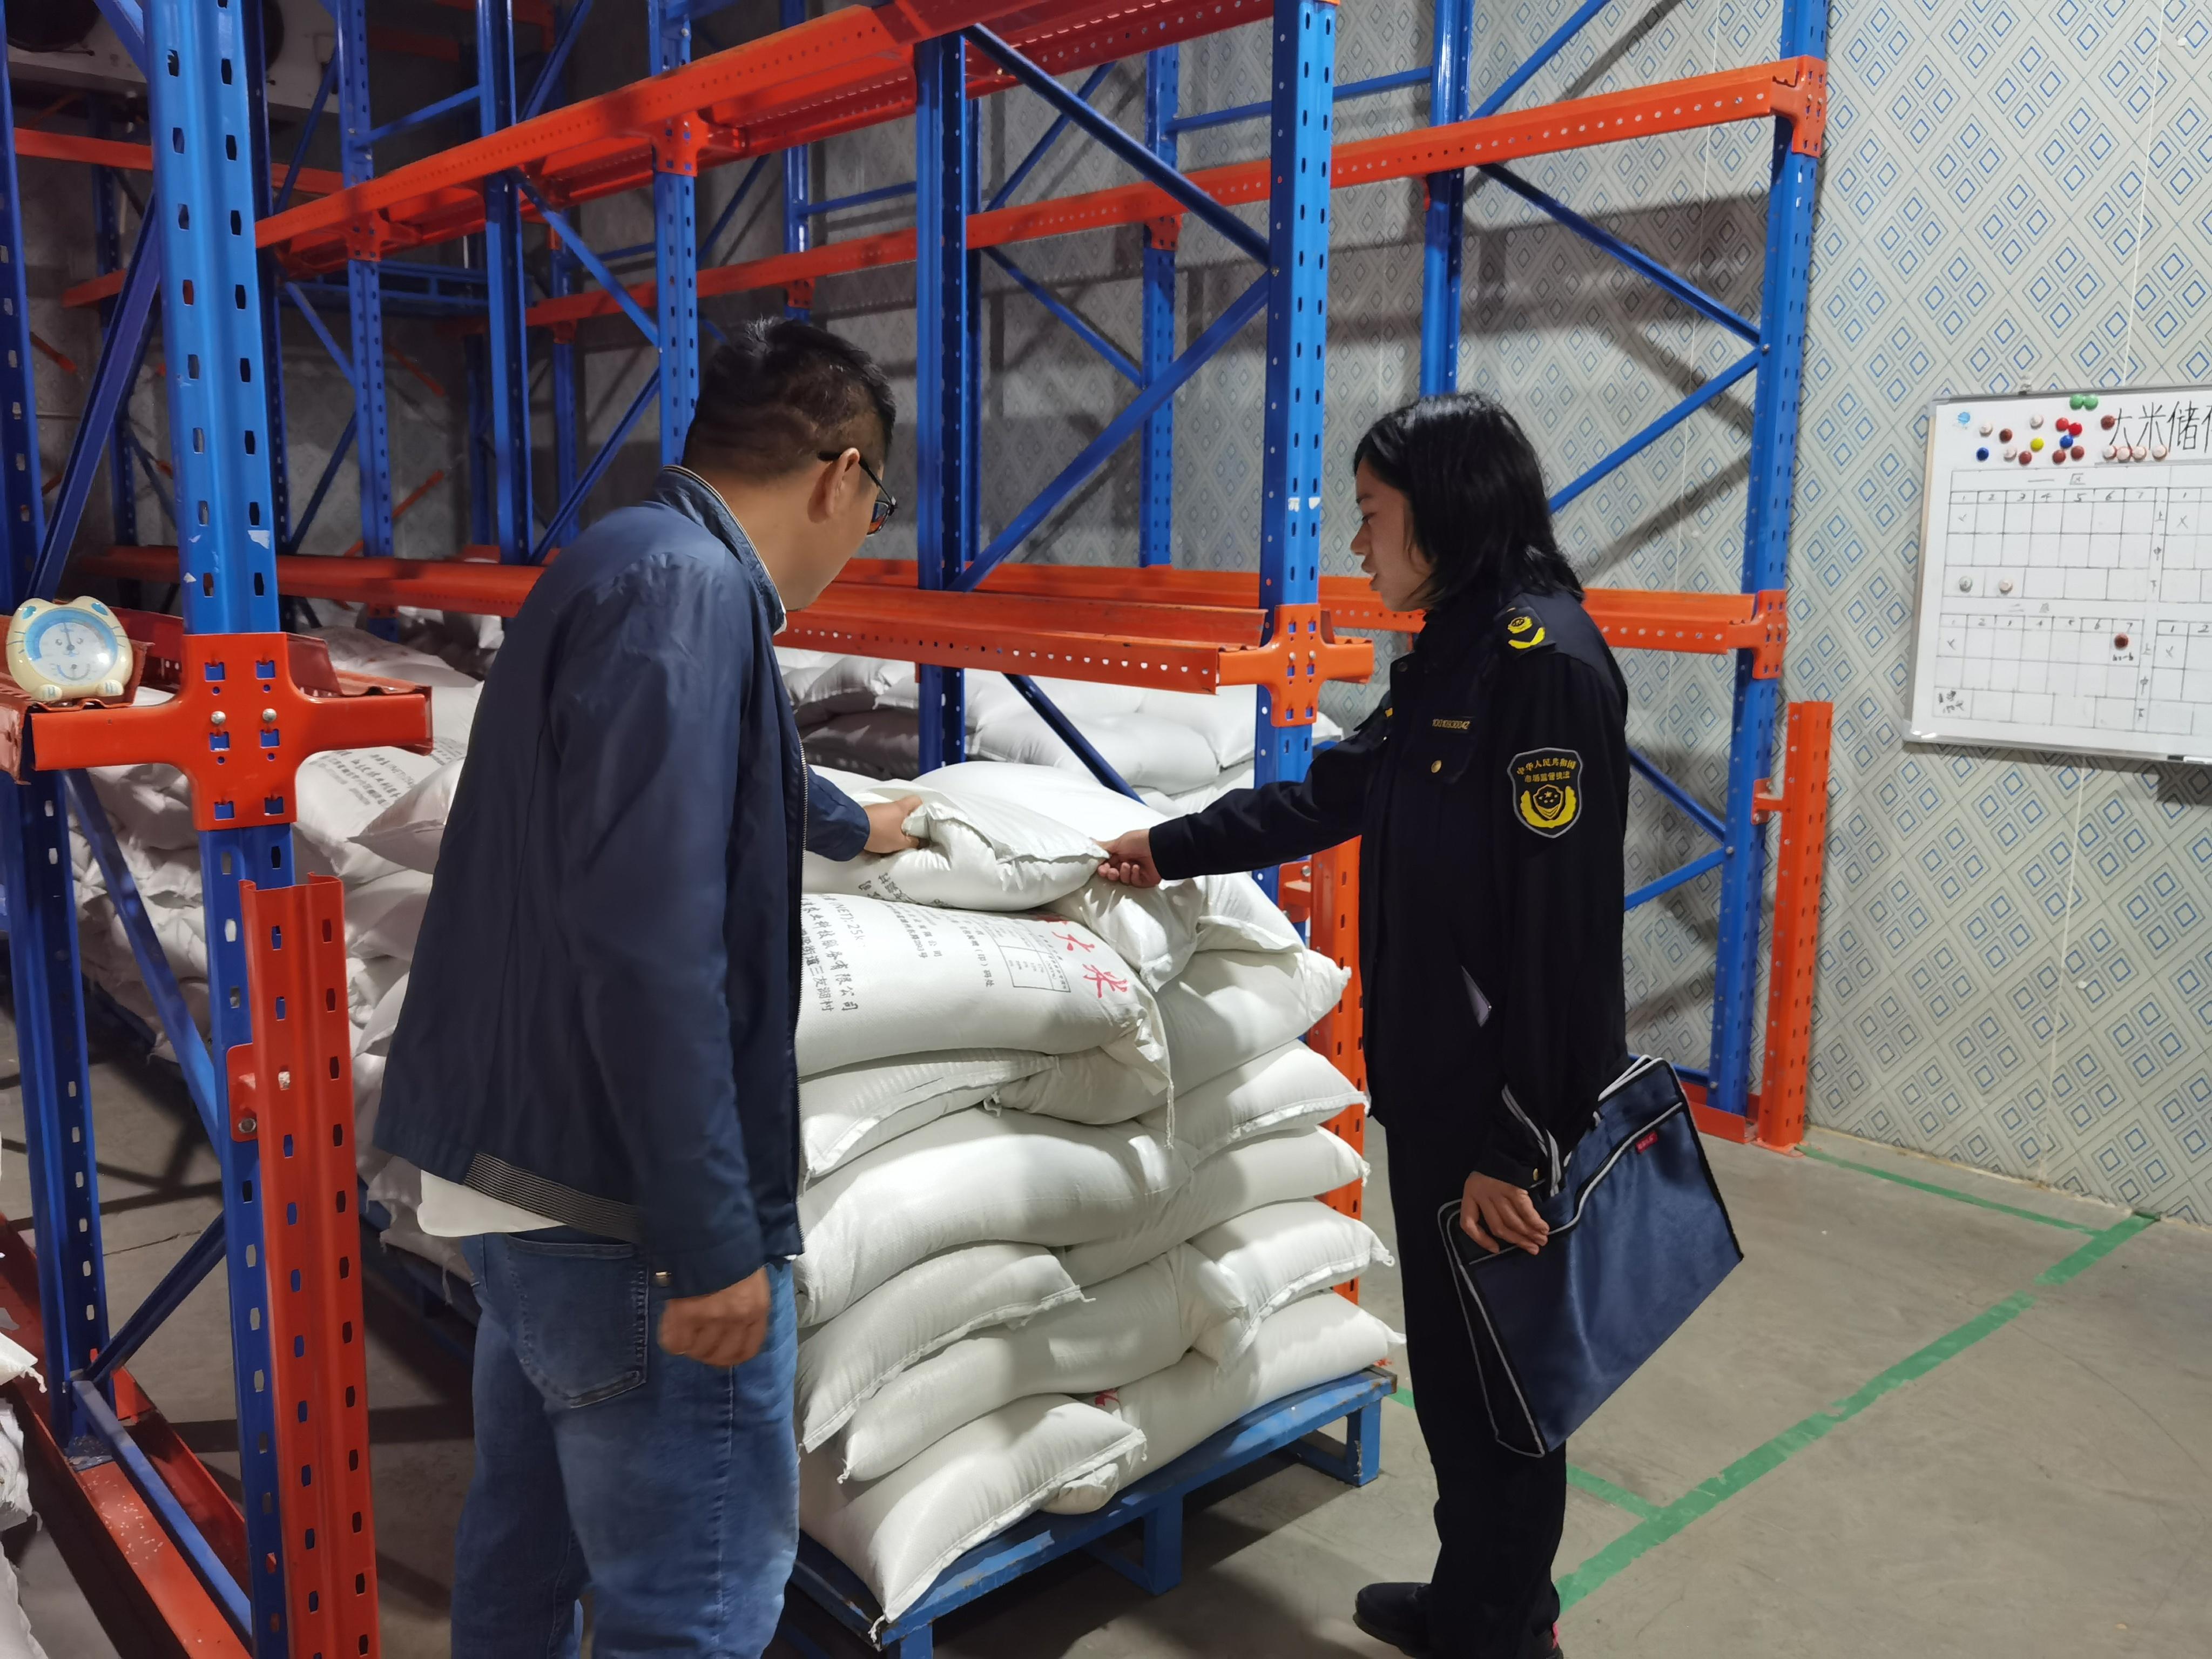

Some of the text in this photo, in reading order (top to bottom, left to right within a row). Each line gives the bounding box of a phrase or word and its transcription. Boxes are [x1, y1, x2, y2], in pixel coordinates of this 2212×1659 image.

[2074, 492, 2087, 503] 5
[2105, 490, 2115, 502] 6
[2197, 624, 2210, 633] 2
[1042, 915, 1128, 999] 大米
